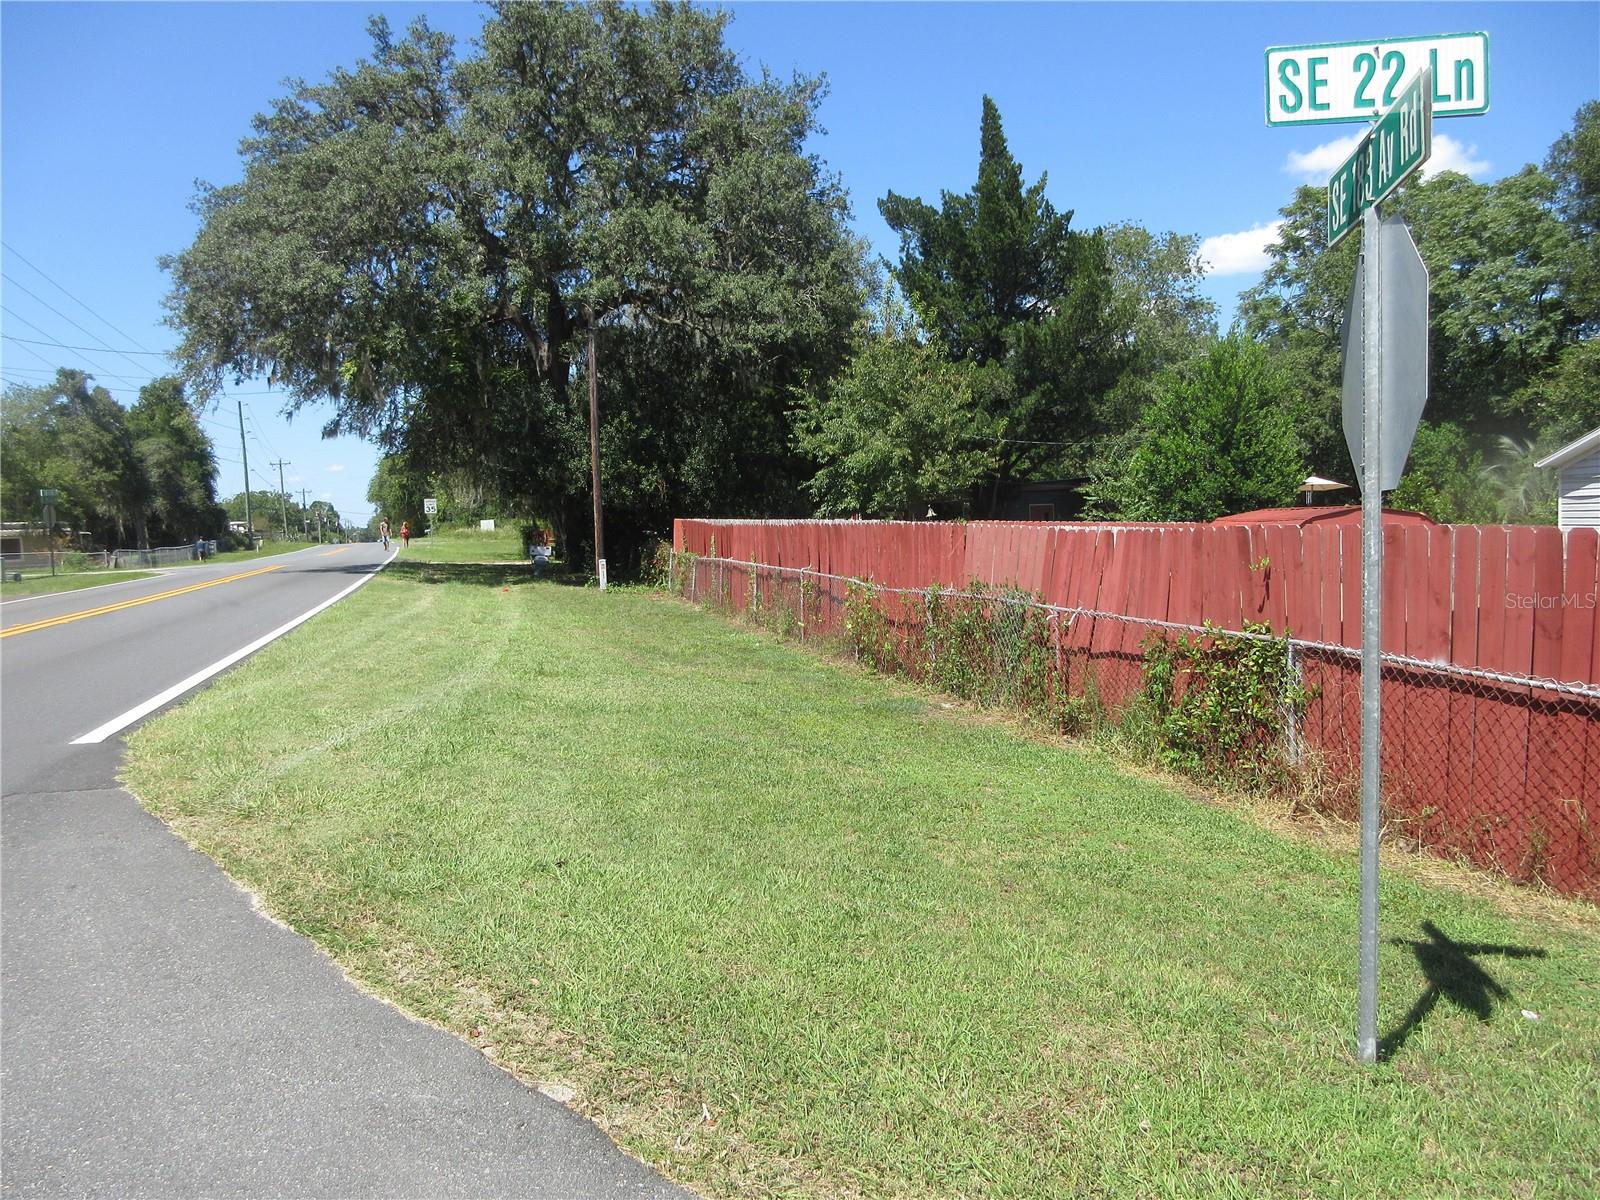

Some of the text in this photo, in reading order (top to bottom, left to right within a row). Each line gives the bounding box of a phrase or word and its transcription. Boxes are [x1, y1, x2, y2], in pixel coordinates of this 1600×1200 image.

[1278, 49, 1474, 113] SE 22 Ln
[1331, 91, 1417, 231] SE 183 Av Rd
